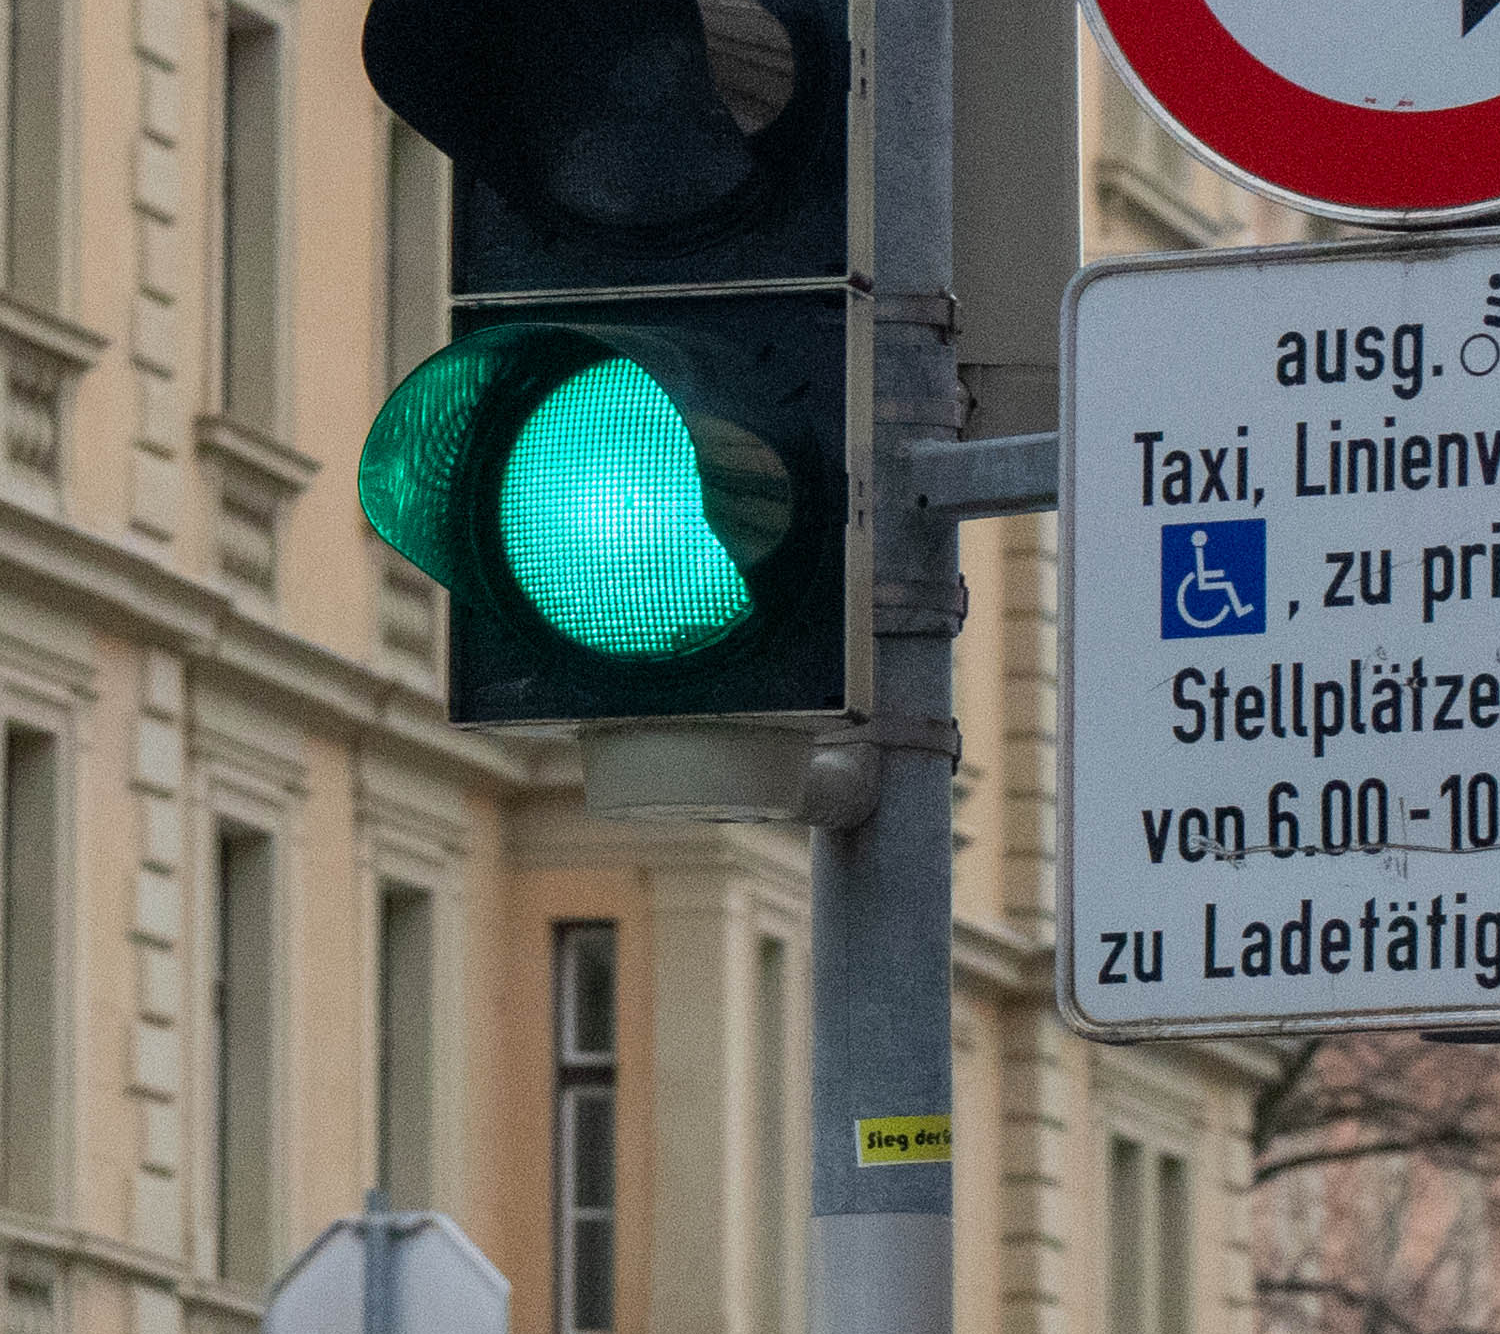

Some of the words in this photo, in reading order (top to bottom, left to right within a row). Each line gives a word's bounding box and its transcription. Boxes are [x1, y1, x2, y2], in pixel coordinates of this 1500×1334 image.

[1277, 322, 1443, 401] ausg.
[1135, 420, 1265, 508] Taxi,
[1324, 549, 1392, 608] zu
[1142, 806, 1248, 864] von
[1098, 931, 1164, 985] zu
[867, 1130, 909, 1152] Sieg
